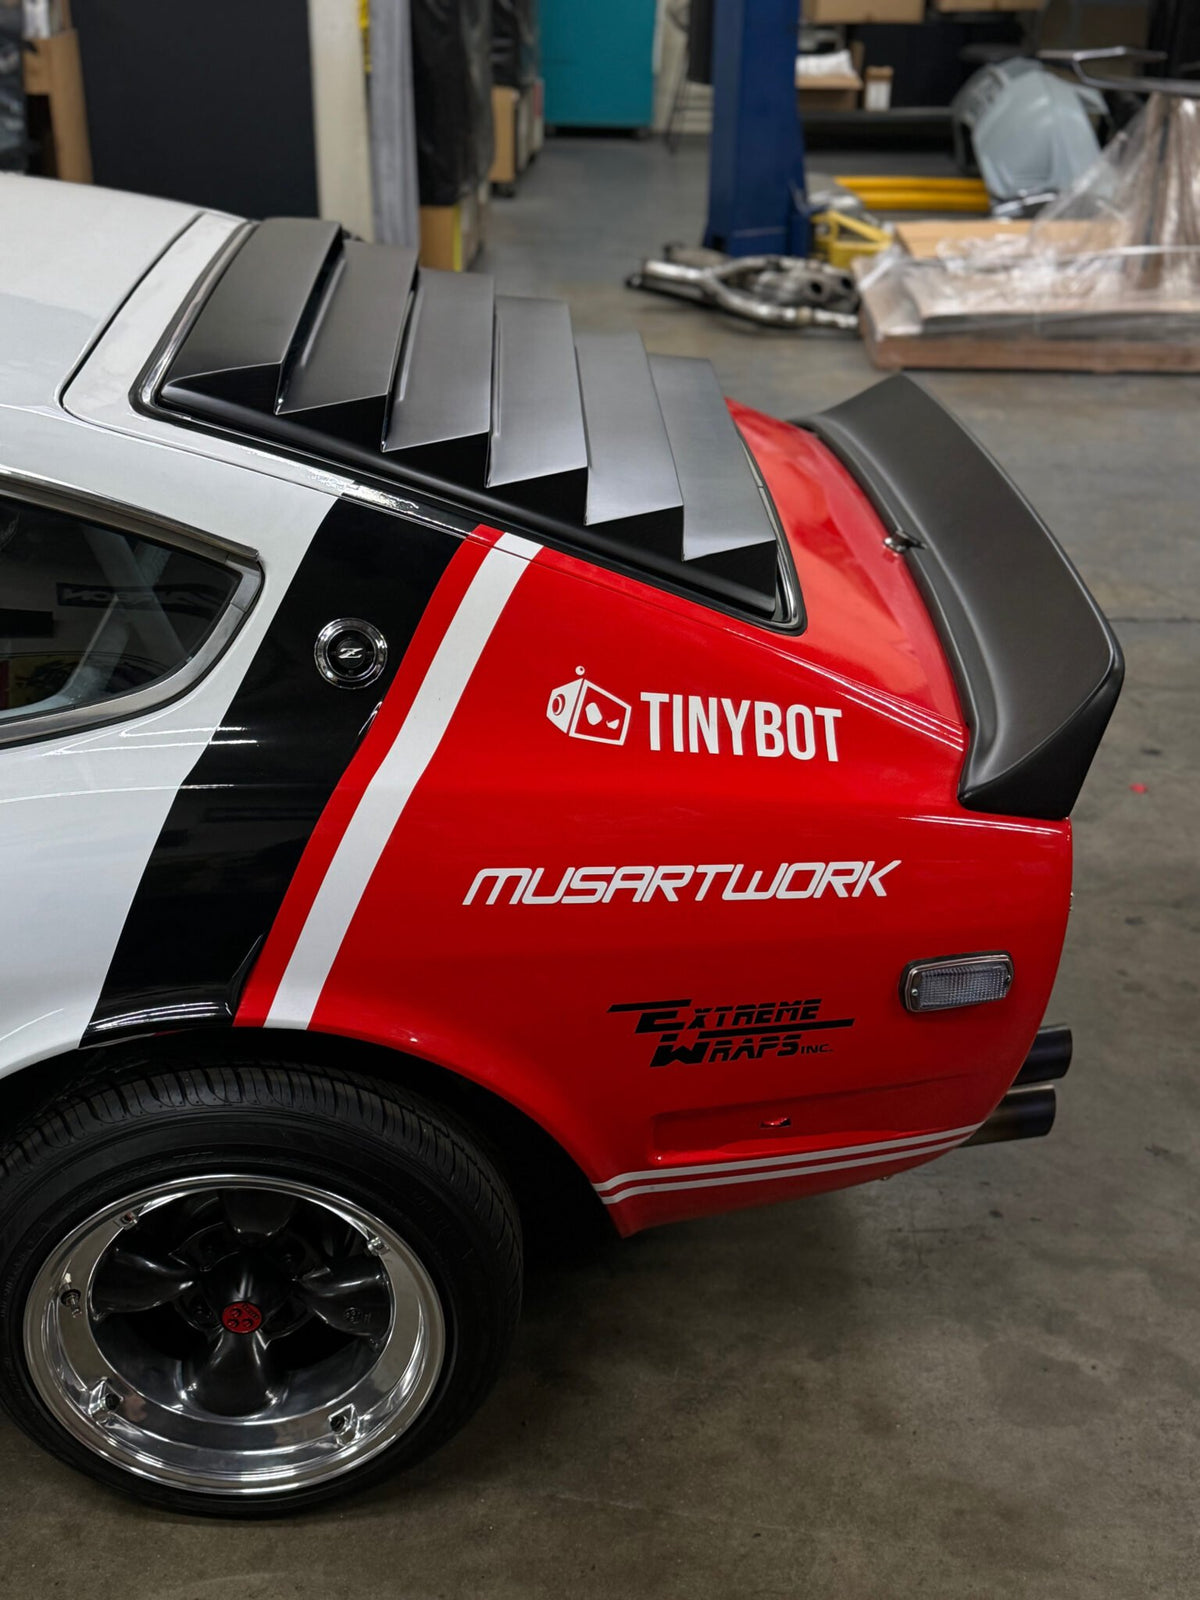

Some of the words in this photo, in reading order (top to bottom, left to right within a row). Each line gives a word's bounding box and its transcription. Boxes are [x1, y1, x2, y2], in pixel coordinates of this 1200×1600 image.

[338, 647, 363, 659] Z
[640, 691, 842, 762] TINYBOT
[462, 859, 902, 906] MUSARTWORK
